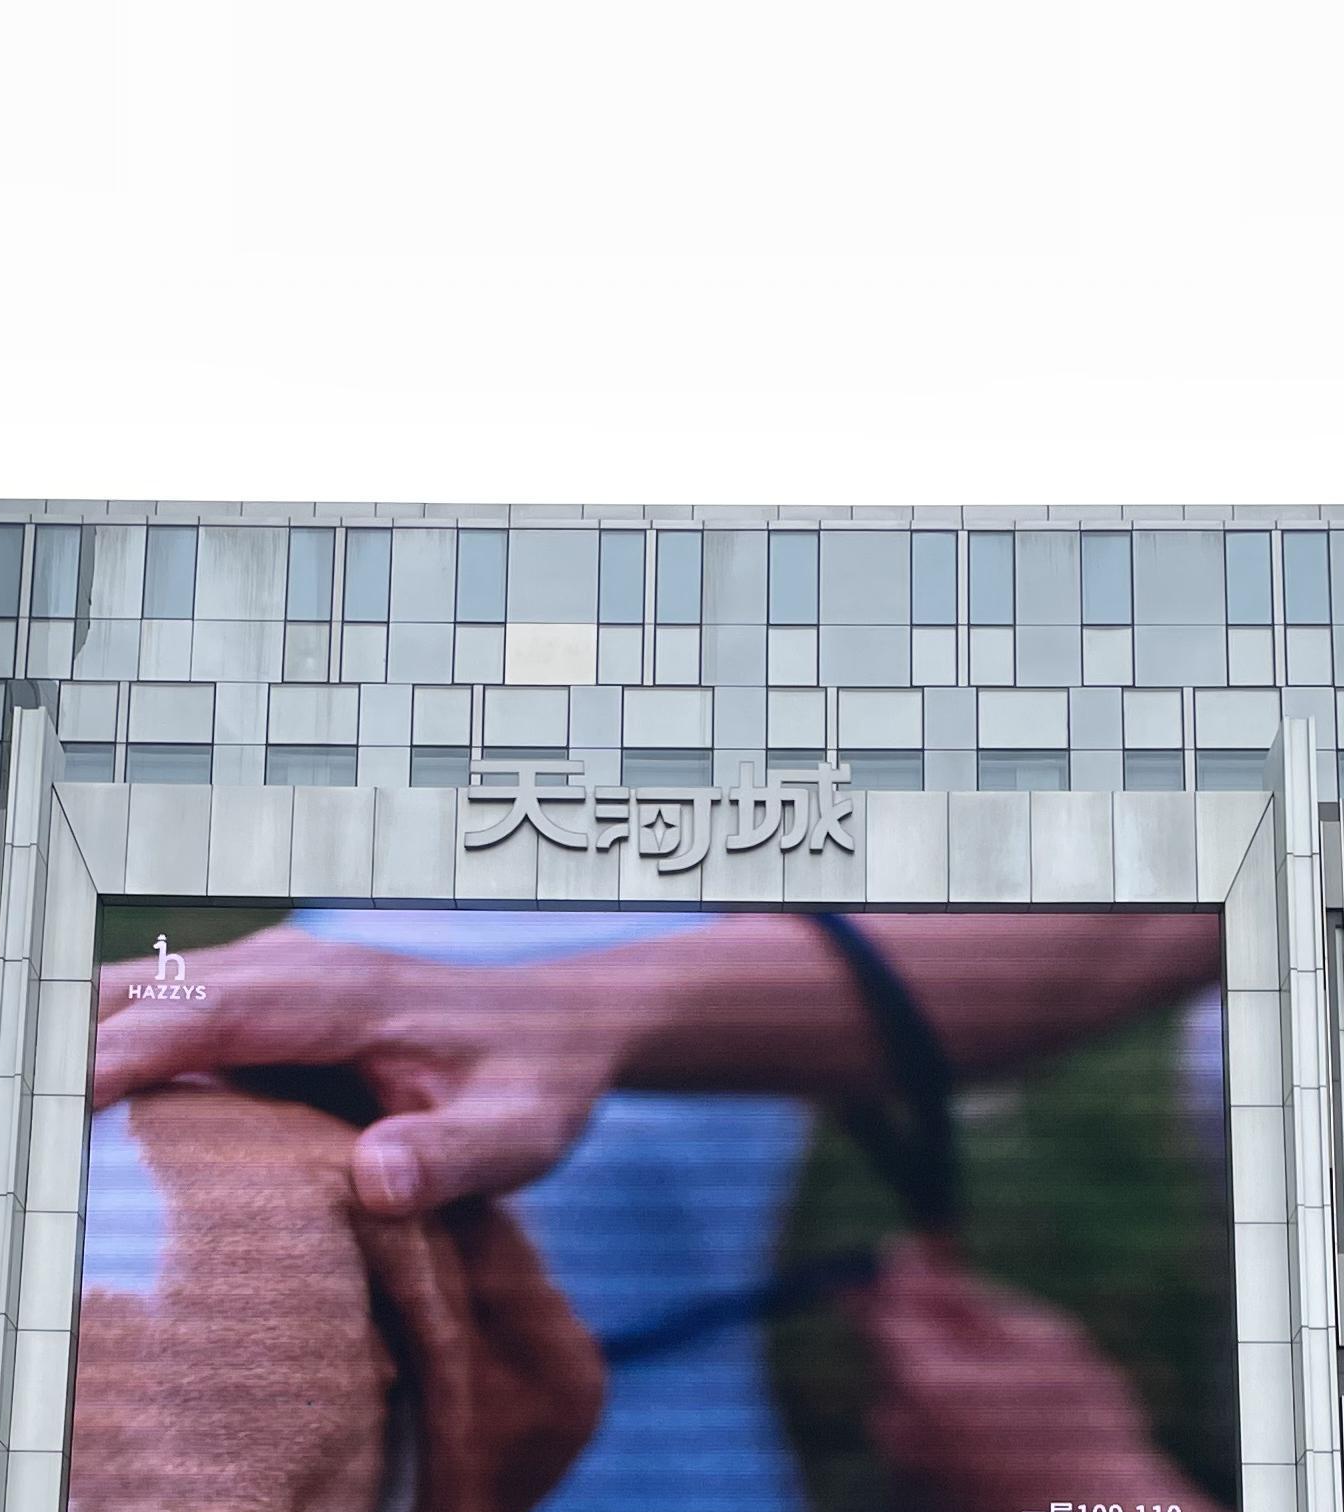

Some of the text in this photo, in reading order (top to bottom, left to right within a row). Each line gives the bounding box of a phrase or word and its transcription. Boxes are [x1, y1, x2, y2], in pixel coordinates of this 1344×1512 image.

[464, 760, 855, 873] 天河城
[128, 984, 207, 1000] HAZZYS
